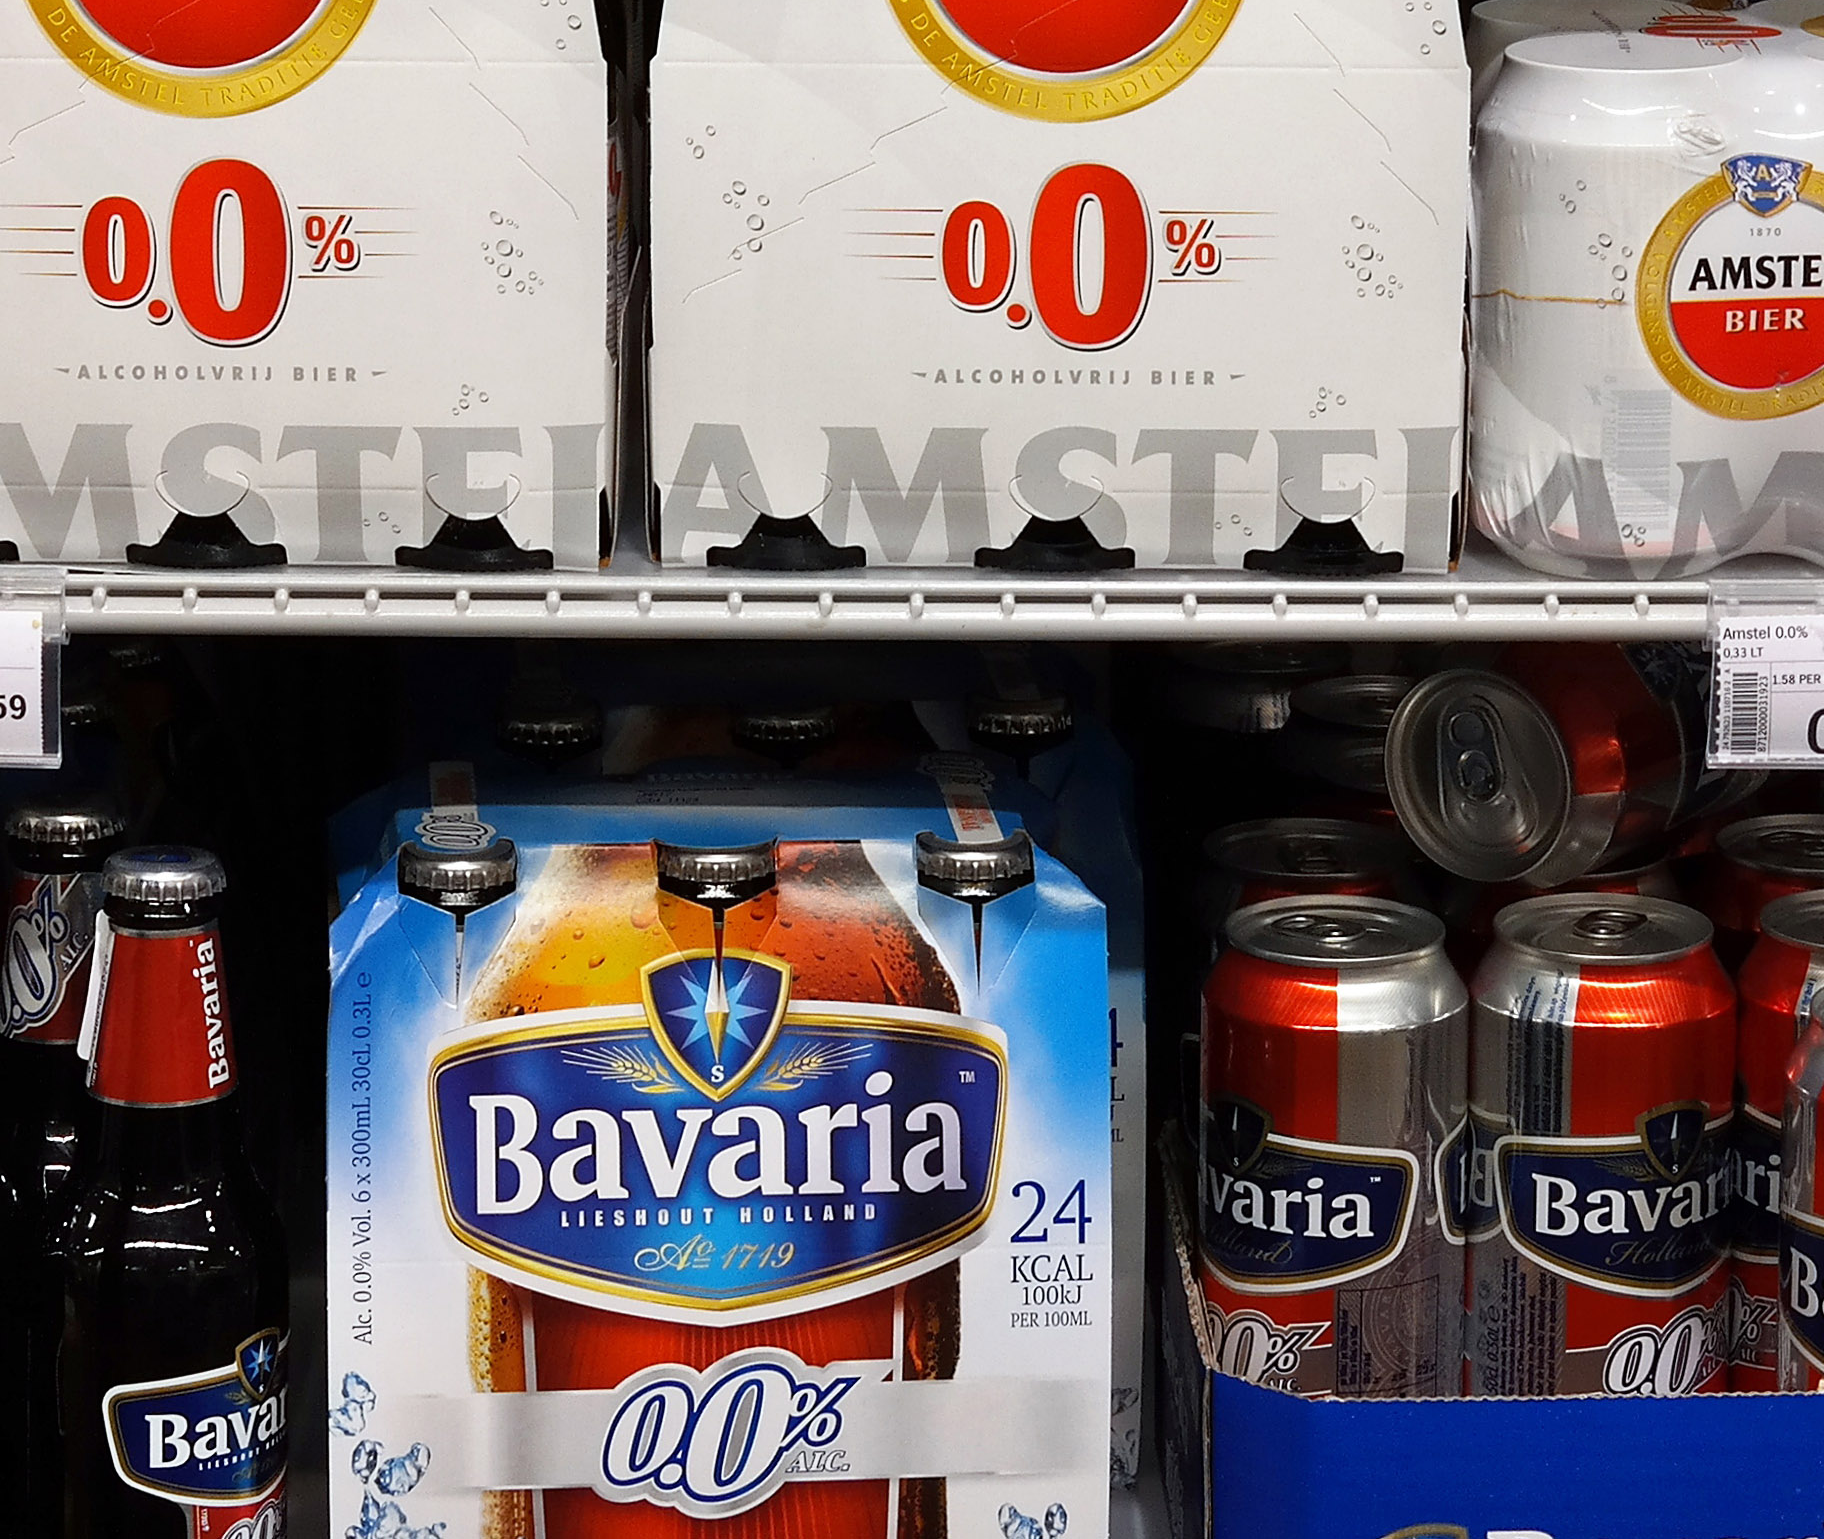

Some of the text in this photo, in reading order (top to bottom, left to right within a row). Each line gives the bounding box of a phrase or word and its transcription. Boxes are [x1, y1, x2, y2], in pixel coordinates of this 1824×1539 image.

[939, 160, 1225, 352] 0.0%
[934, 367, 1217, 387] ALCOHOLVRIJ BIER
[195, 936, 231, 1092] Bavaria
[351, 995, 372, 1345] Alc. 0.0% Vol. 6 x 300mL 30cL 0.3L
[467, 1069, 968, 1217] Bavaria
[561, 1202, 877, 1228] LIESHOUT HOLLAND
[1009, 1178, 1093, 1246] 24
[1010, 1255, 1093, 1283] KCAL
[1022, 1285, 1082, 1307] 100kJ
[1010, 1311, 1093, 1328] PER 100ML
[603, 1361, 862, 1494] 0.0%
